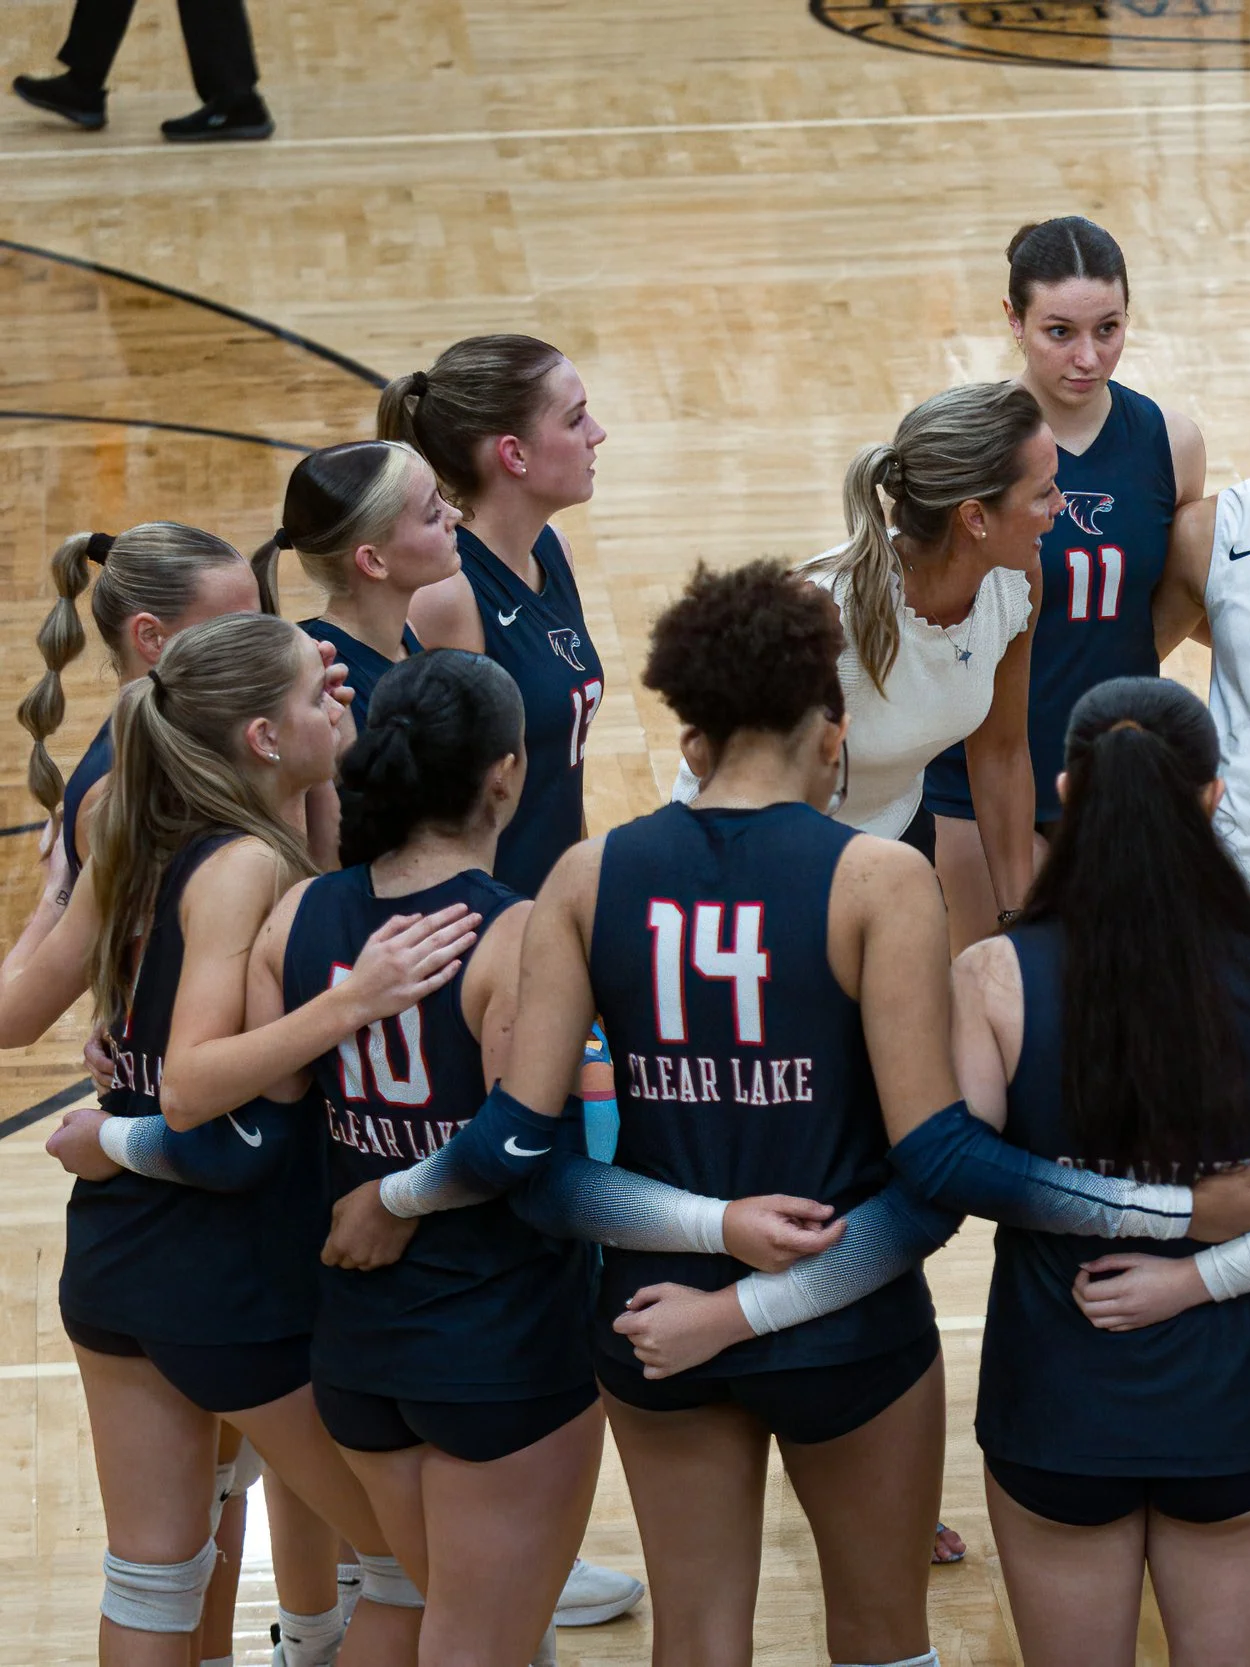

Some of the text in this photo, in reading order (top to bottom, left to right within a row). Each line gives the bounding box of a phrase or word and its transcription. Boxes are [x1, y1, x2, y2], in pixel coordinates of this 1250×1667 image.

[1065, 544, 1125, 622] 11
[647, 897, 771, 1047] 14
[328, 961, 433, 1108] 10
[629, 1053, 813, 1105] CLEAR LAKE
